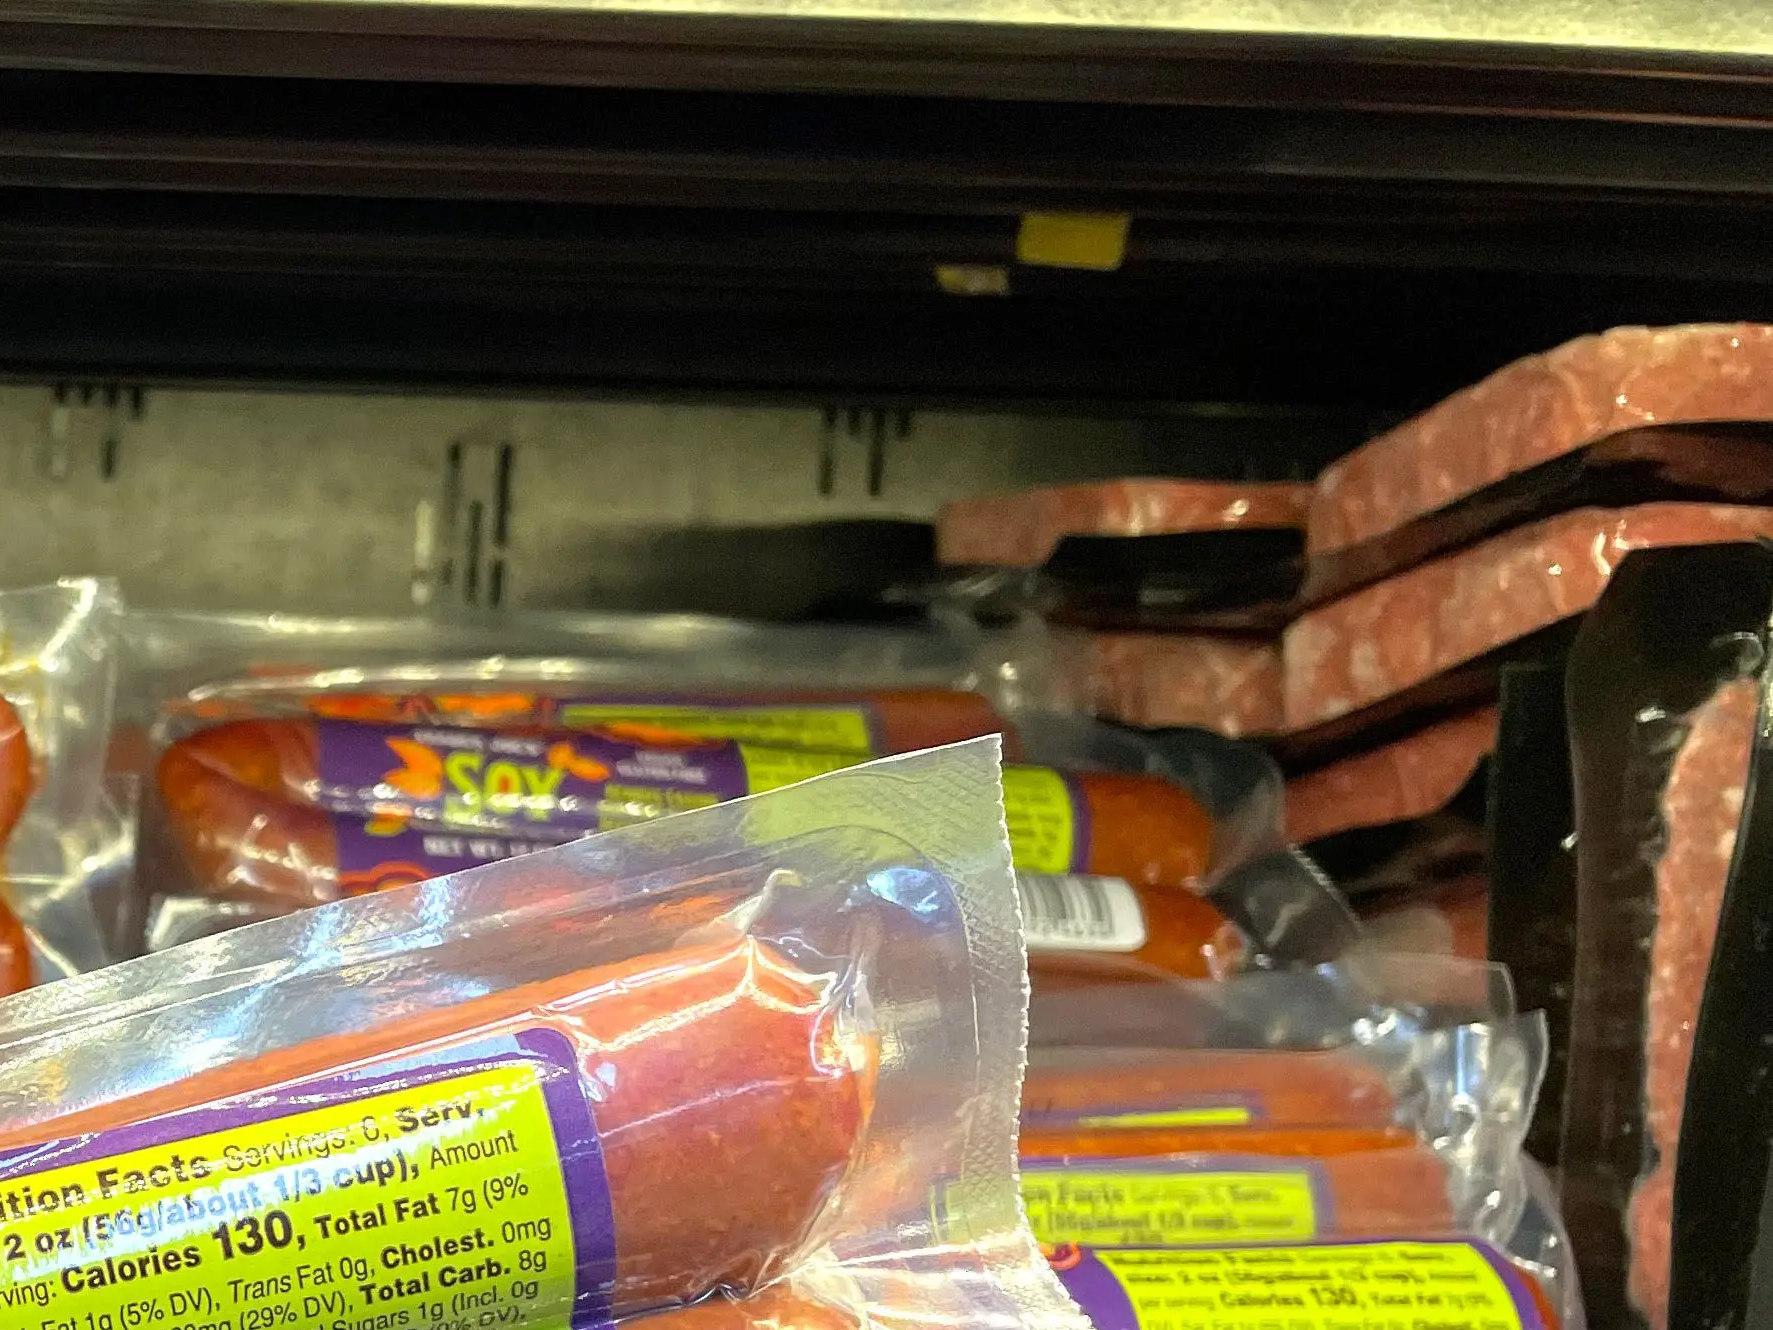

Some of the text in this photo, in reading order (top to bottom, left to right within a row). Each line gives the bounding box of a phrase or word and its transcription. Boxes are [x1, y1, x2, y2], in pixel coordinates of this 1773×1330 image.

[4, 1233, 25, 1260] 2
[35, 1229, 72, 1252] oz
[275, 1165, 323, 1204] 1/3
[329, 1145, 421, 1196] cup),
[430, 1130, 517, 1169] Amount
[96, 1155, 210, 1199] Facts
[61, 1246, 201, 1292] Calories
[212, 1210, 305, 1259] 130,
[314, 1203, 386, 1238] Total
[393, 1193, 440, 1222] Fat
[445, 1186, 476, 1213] 7g
[483, 1173, 528, 1208] (9%
[227, 1275, 291, 1302] Trans
[296, 1262, 334, 1288] Fat
[339, 1257, 374, 1281] 0g,
[381, 1228, 493, 1268] Cholest.
[501, 1217, 551, 1243] 0mg
[359, 1272, 429, 1304] Total
[438, 1258, 510, 1287] Carb.
[518, 1249, 546, 1272] 8g
[451, 1285, 503, 1316] (Incl.
